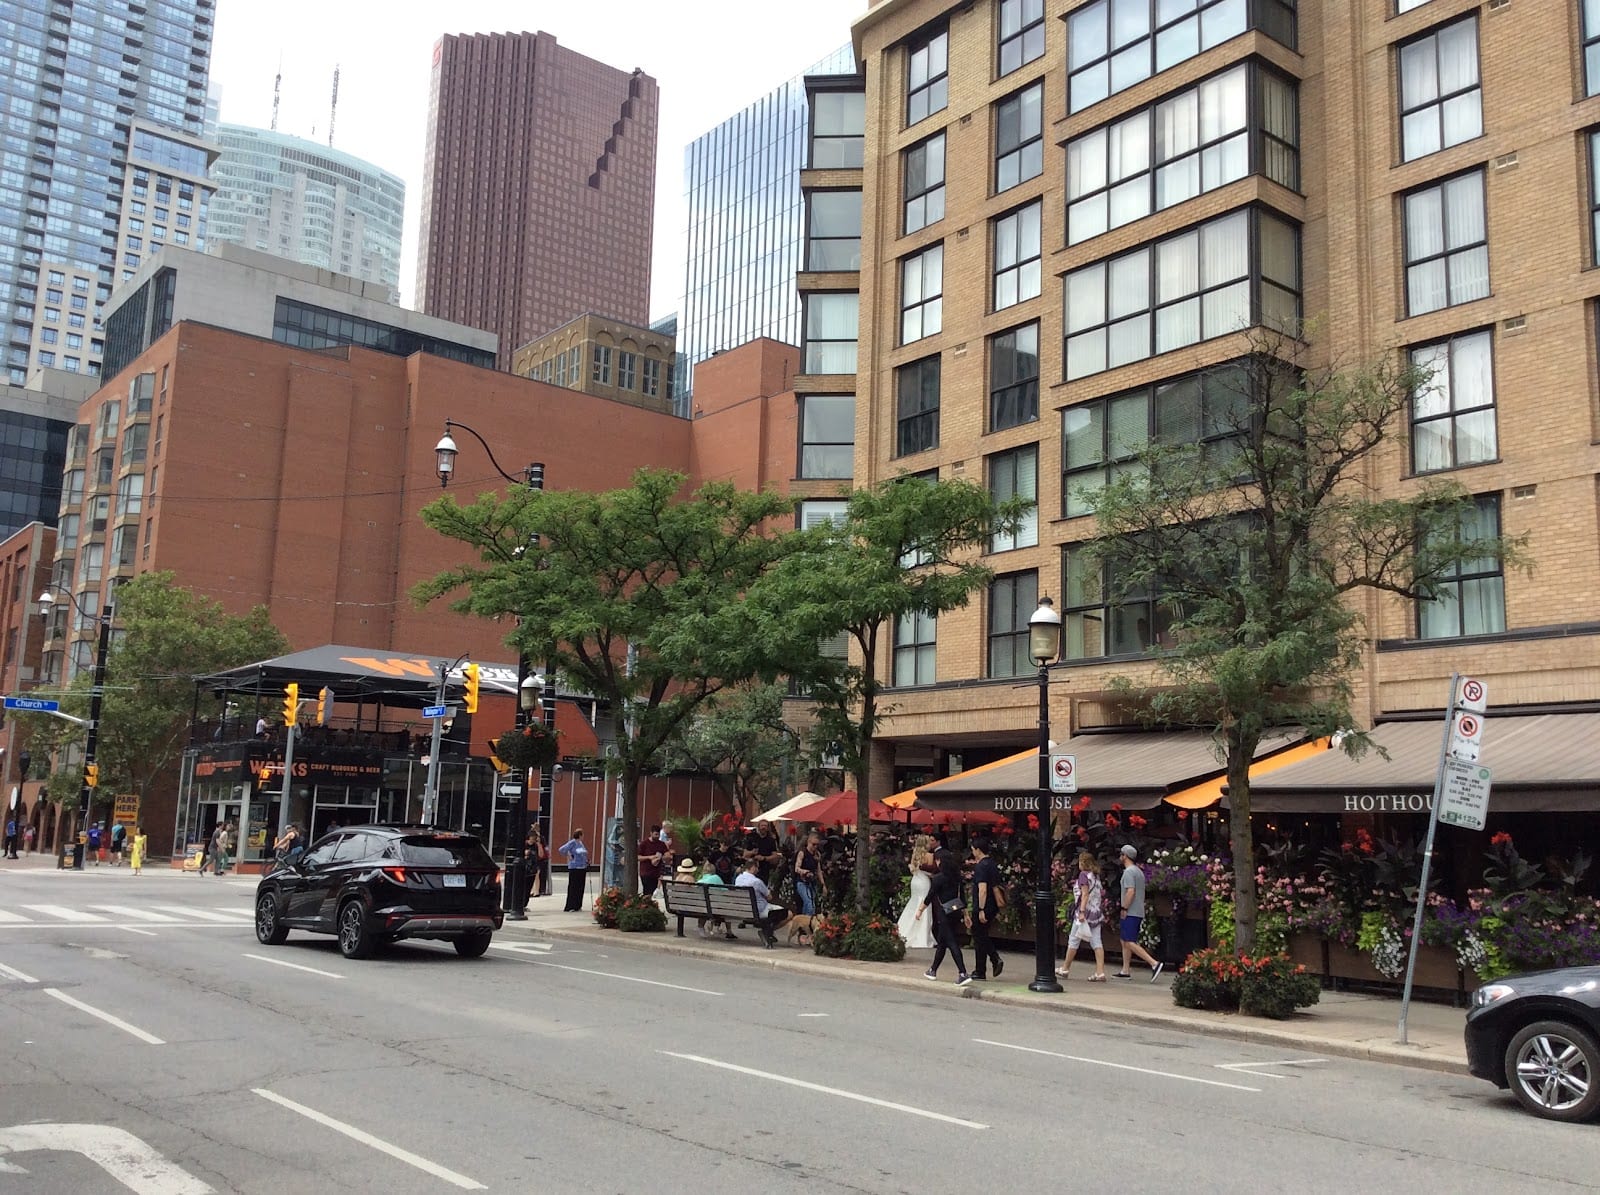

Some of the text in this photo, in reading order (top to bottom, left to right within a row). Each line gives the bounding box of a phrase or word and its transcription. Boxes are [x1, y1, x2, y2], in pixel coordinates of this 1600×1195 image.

[15, 699, 42, 708] Church
[116, 795, 137, 804] PARK
[1343, 794, 1433, 811] HOTHOU
[116, 804, 137, 812] HERE
